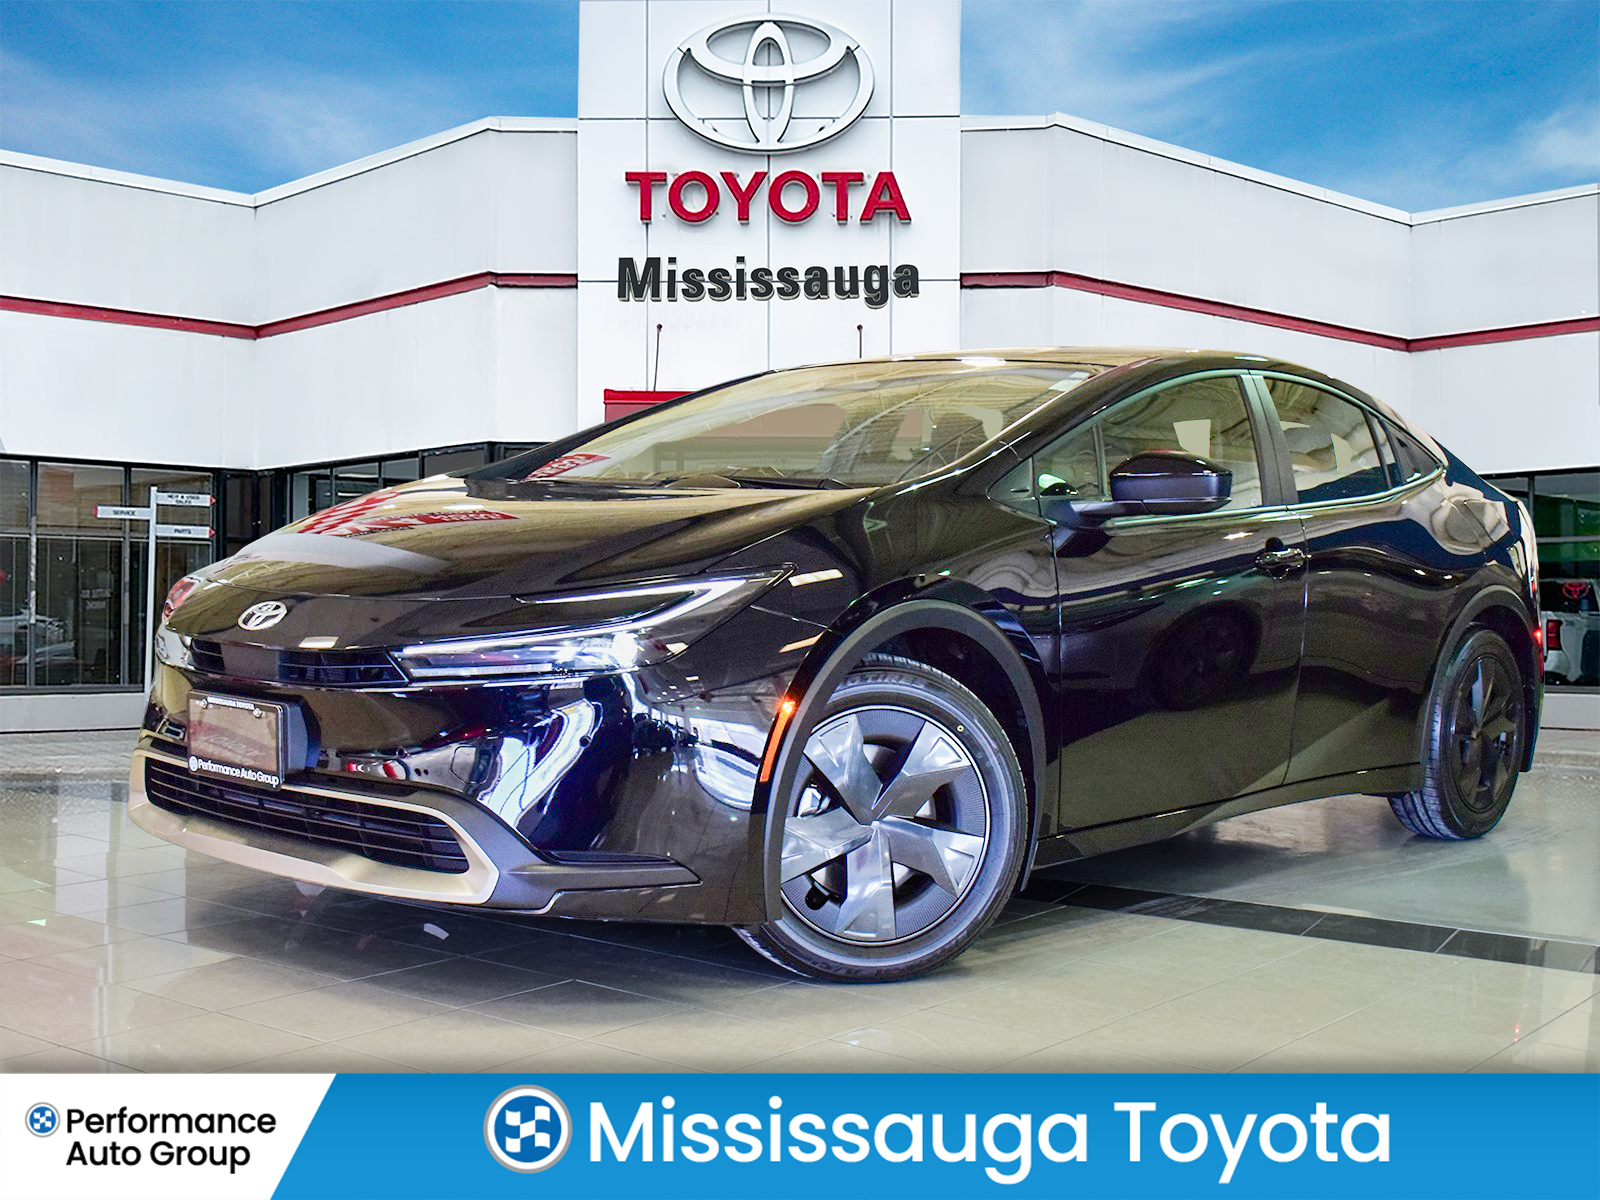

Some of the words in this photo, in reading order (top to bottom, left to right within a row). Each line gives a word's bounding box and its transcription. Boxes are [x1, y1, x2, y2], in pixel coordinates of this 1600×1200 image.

[625, 170, 912, 225] TOYOTA
[617, 256, 920, 309] Mississauga
[197, 759, 240, 777] Performance
[240, 767, 257, 781] Auto
[257, 771, 279, 788] Group
